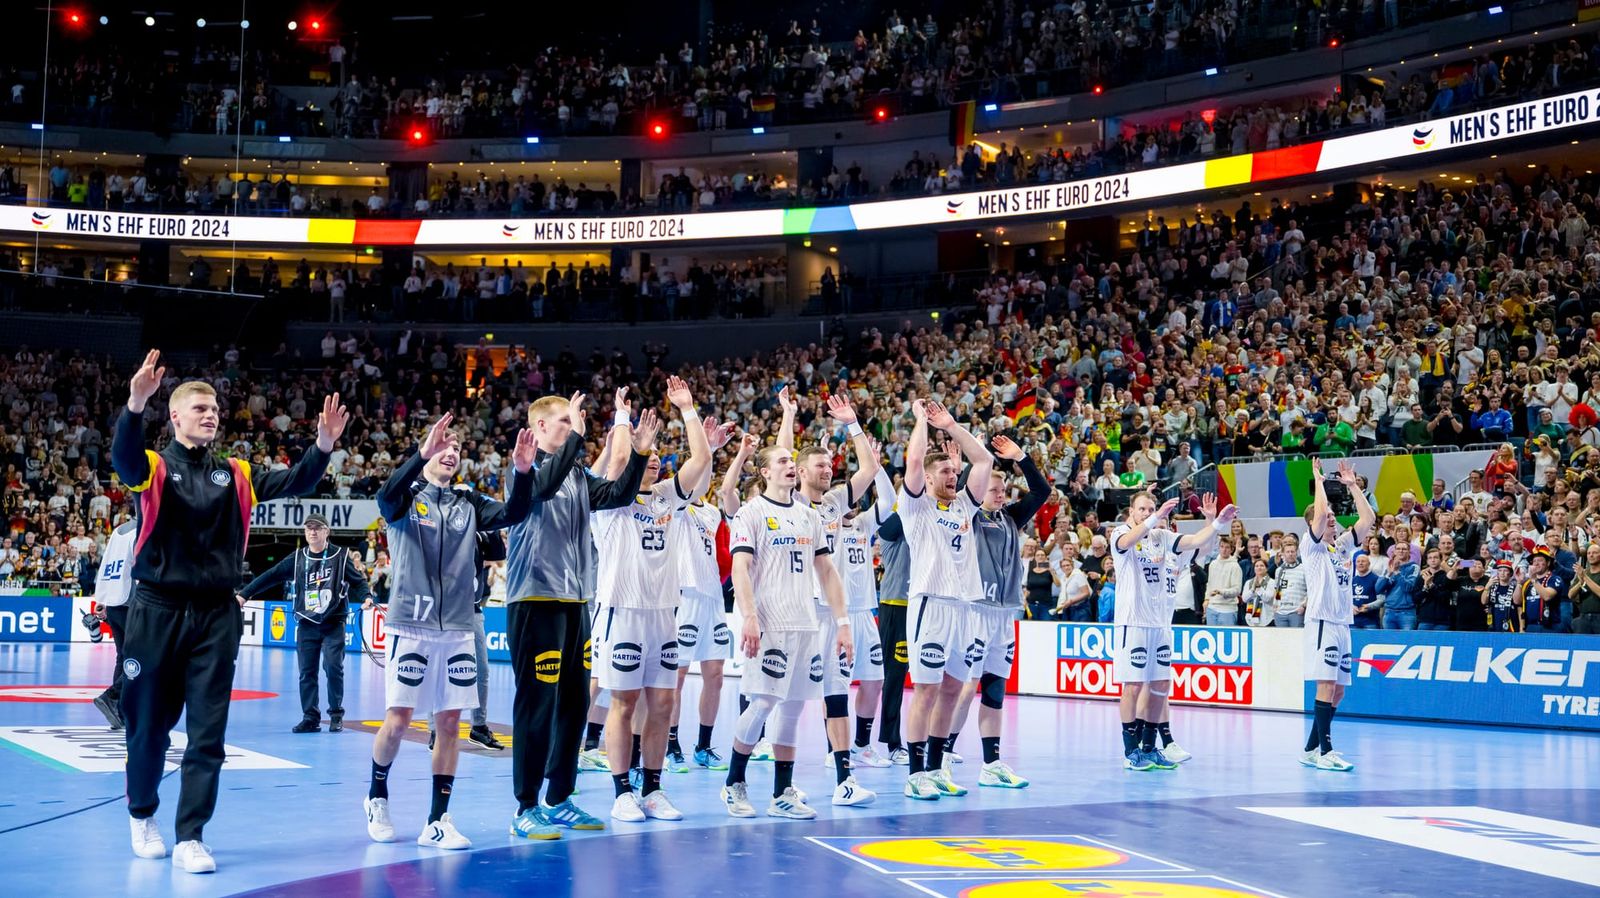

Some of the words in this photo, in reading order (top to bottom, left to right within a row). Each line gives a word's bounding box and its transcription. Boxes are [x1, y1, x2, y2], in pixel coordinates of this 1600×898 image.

[1506, 105, 1537, 134] EHF
[1543, 95, 1589, 127] EURO
[1026, 189, 1050, 211] EHF
[1056, 184, 1089, 208] EURO
[1094, 177, 1130, 202] 2024
[117, 216, 144, 235] EHF
[150, 217, 186, 237] EURO
[191, 218, 230, 237] 2024
[581, 222, 606, 240] EHF
[611, 220, 644, 239] EURO
[650, 218, 684, 237] 2024
[283, 503, 304, 526] TO
[641, 529, 665, 551] 23
[951, 534, 962, 552] 4
[790, 550, 804, 573] 15
[1143, 567, 1160, 583] 25
[983, 581, 998, 602] 14
[413, 594, 435, 622] 17
[612, 652, 642, 661] HARTING
[1171, 629, 1249, 665] LIQUI
[1059, 661, 1120, 694] MOL
[1168, 666, 1252, 702] MOLY
[1542, 694, 1600, 717] TYRE
